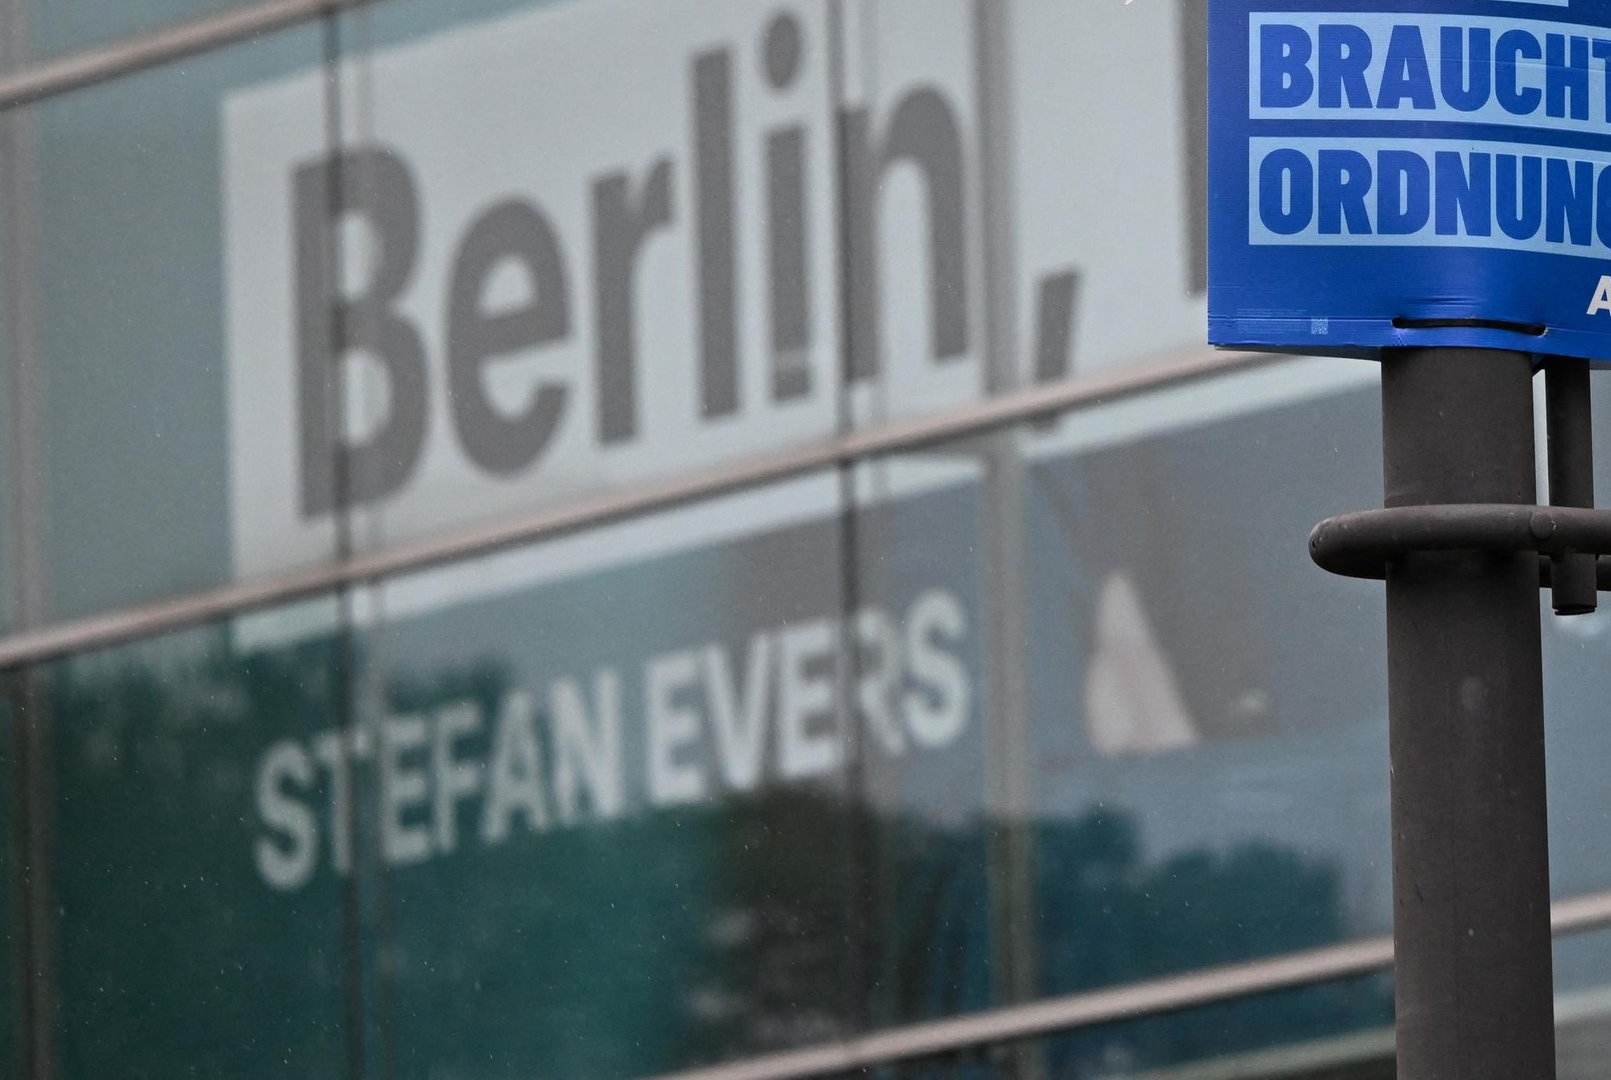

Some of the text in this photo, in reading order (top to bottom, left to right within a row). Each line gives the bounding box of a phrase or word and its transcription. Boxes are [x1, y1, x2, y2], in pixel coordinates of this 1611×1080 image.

[290, 8, 1082, 524] Berlin,
[254, 588, 973, 892] STEFAN EVERS
